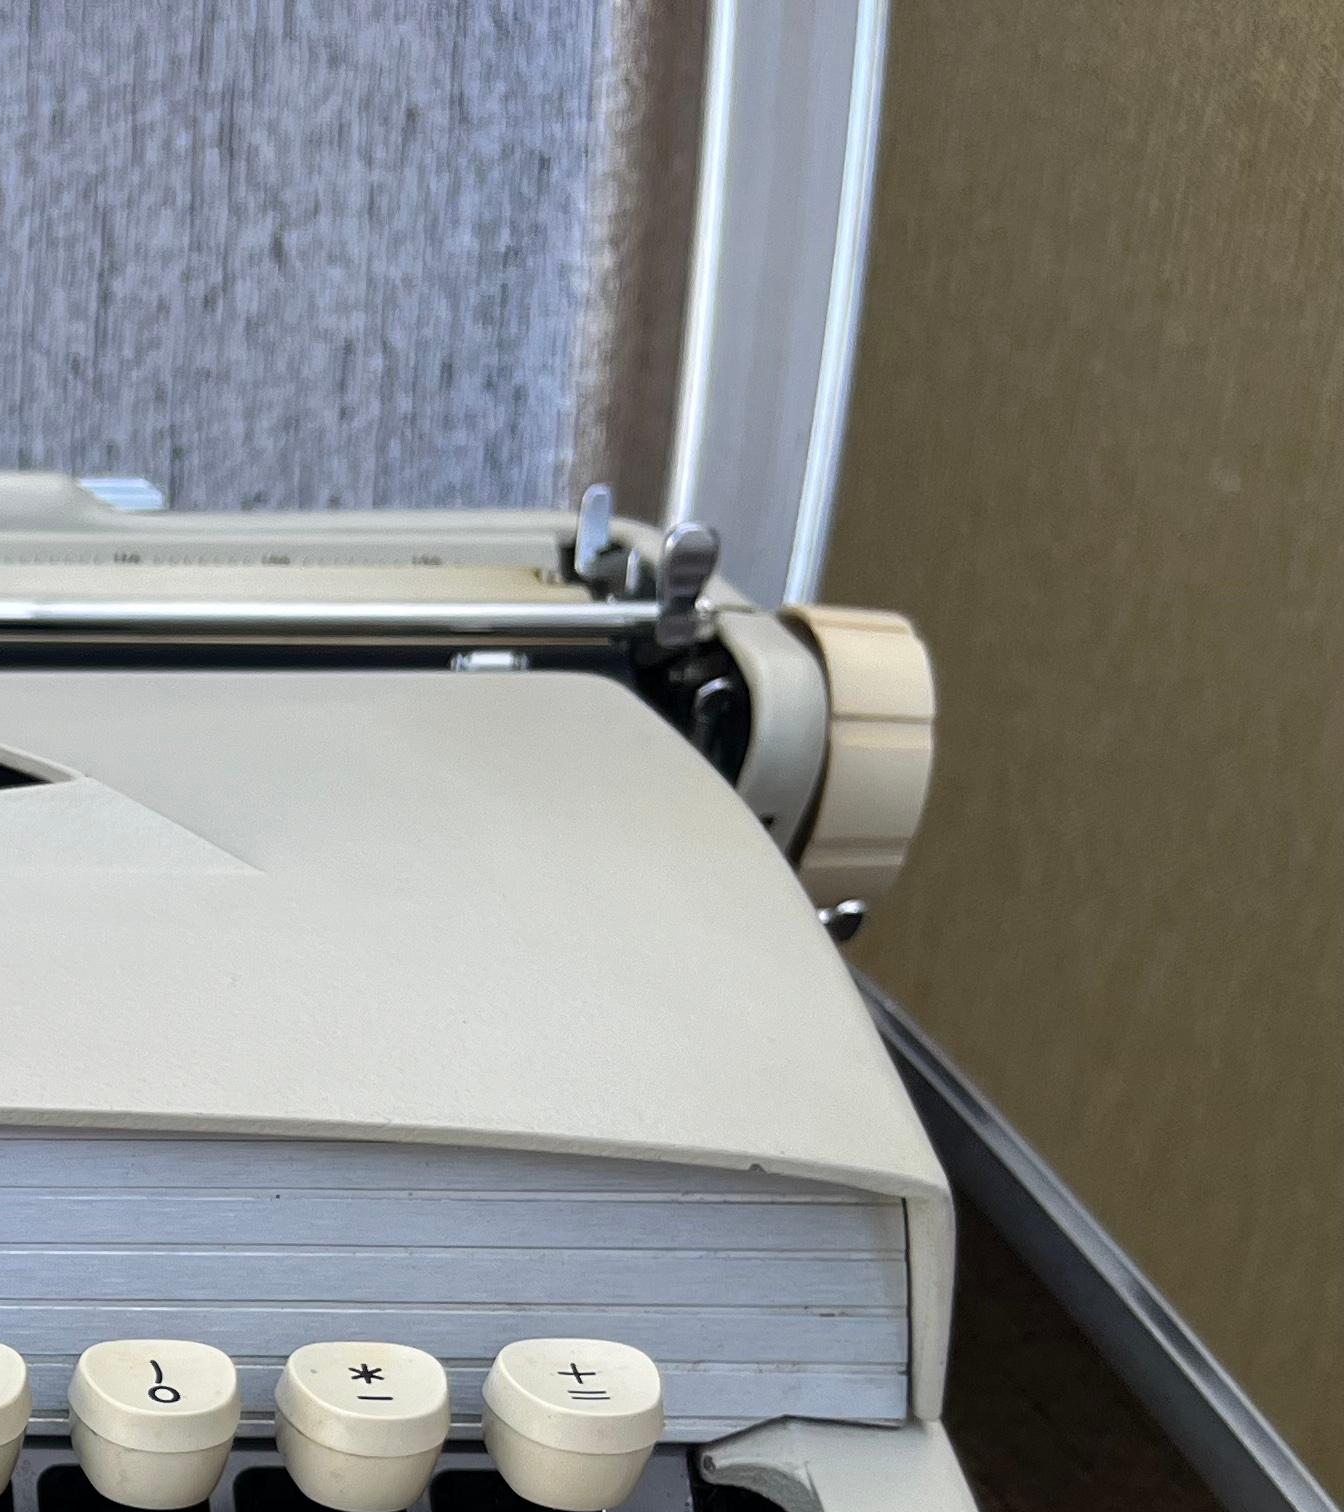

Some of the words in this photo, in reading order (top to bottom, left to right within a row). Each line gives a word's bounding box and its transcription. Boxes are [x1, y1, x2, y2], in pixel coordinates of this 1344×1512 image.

[149, 1359, 163, 1385] )
[557, 1362, 596, 1385] +
[147, 1385, 181, 1404] 0
[567, 1390, 611, 1401] =
